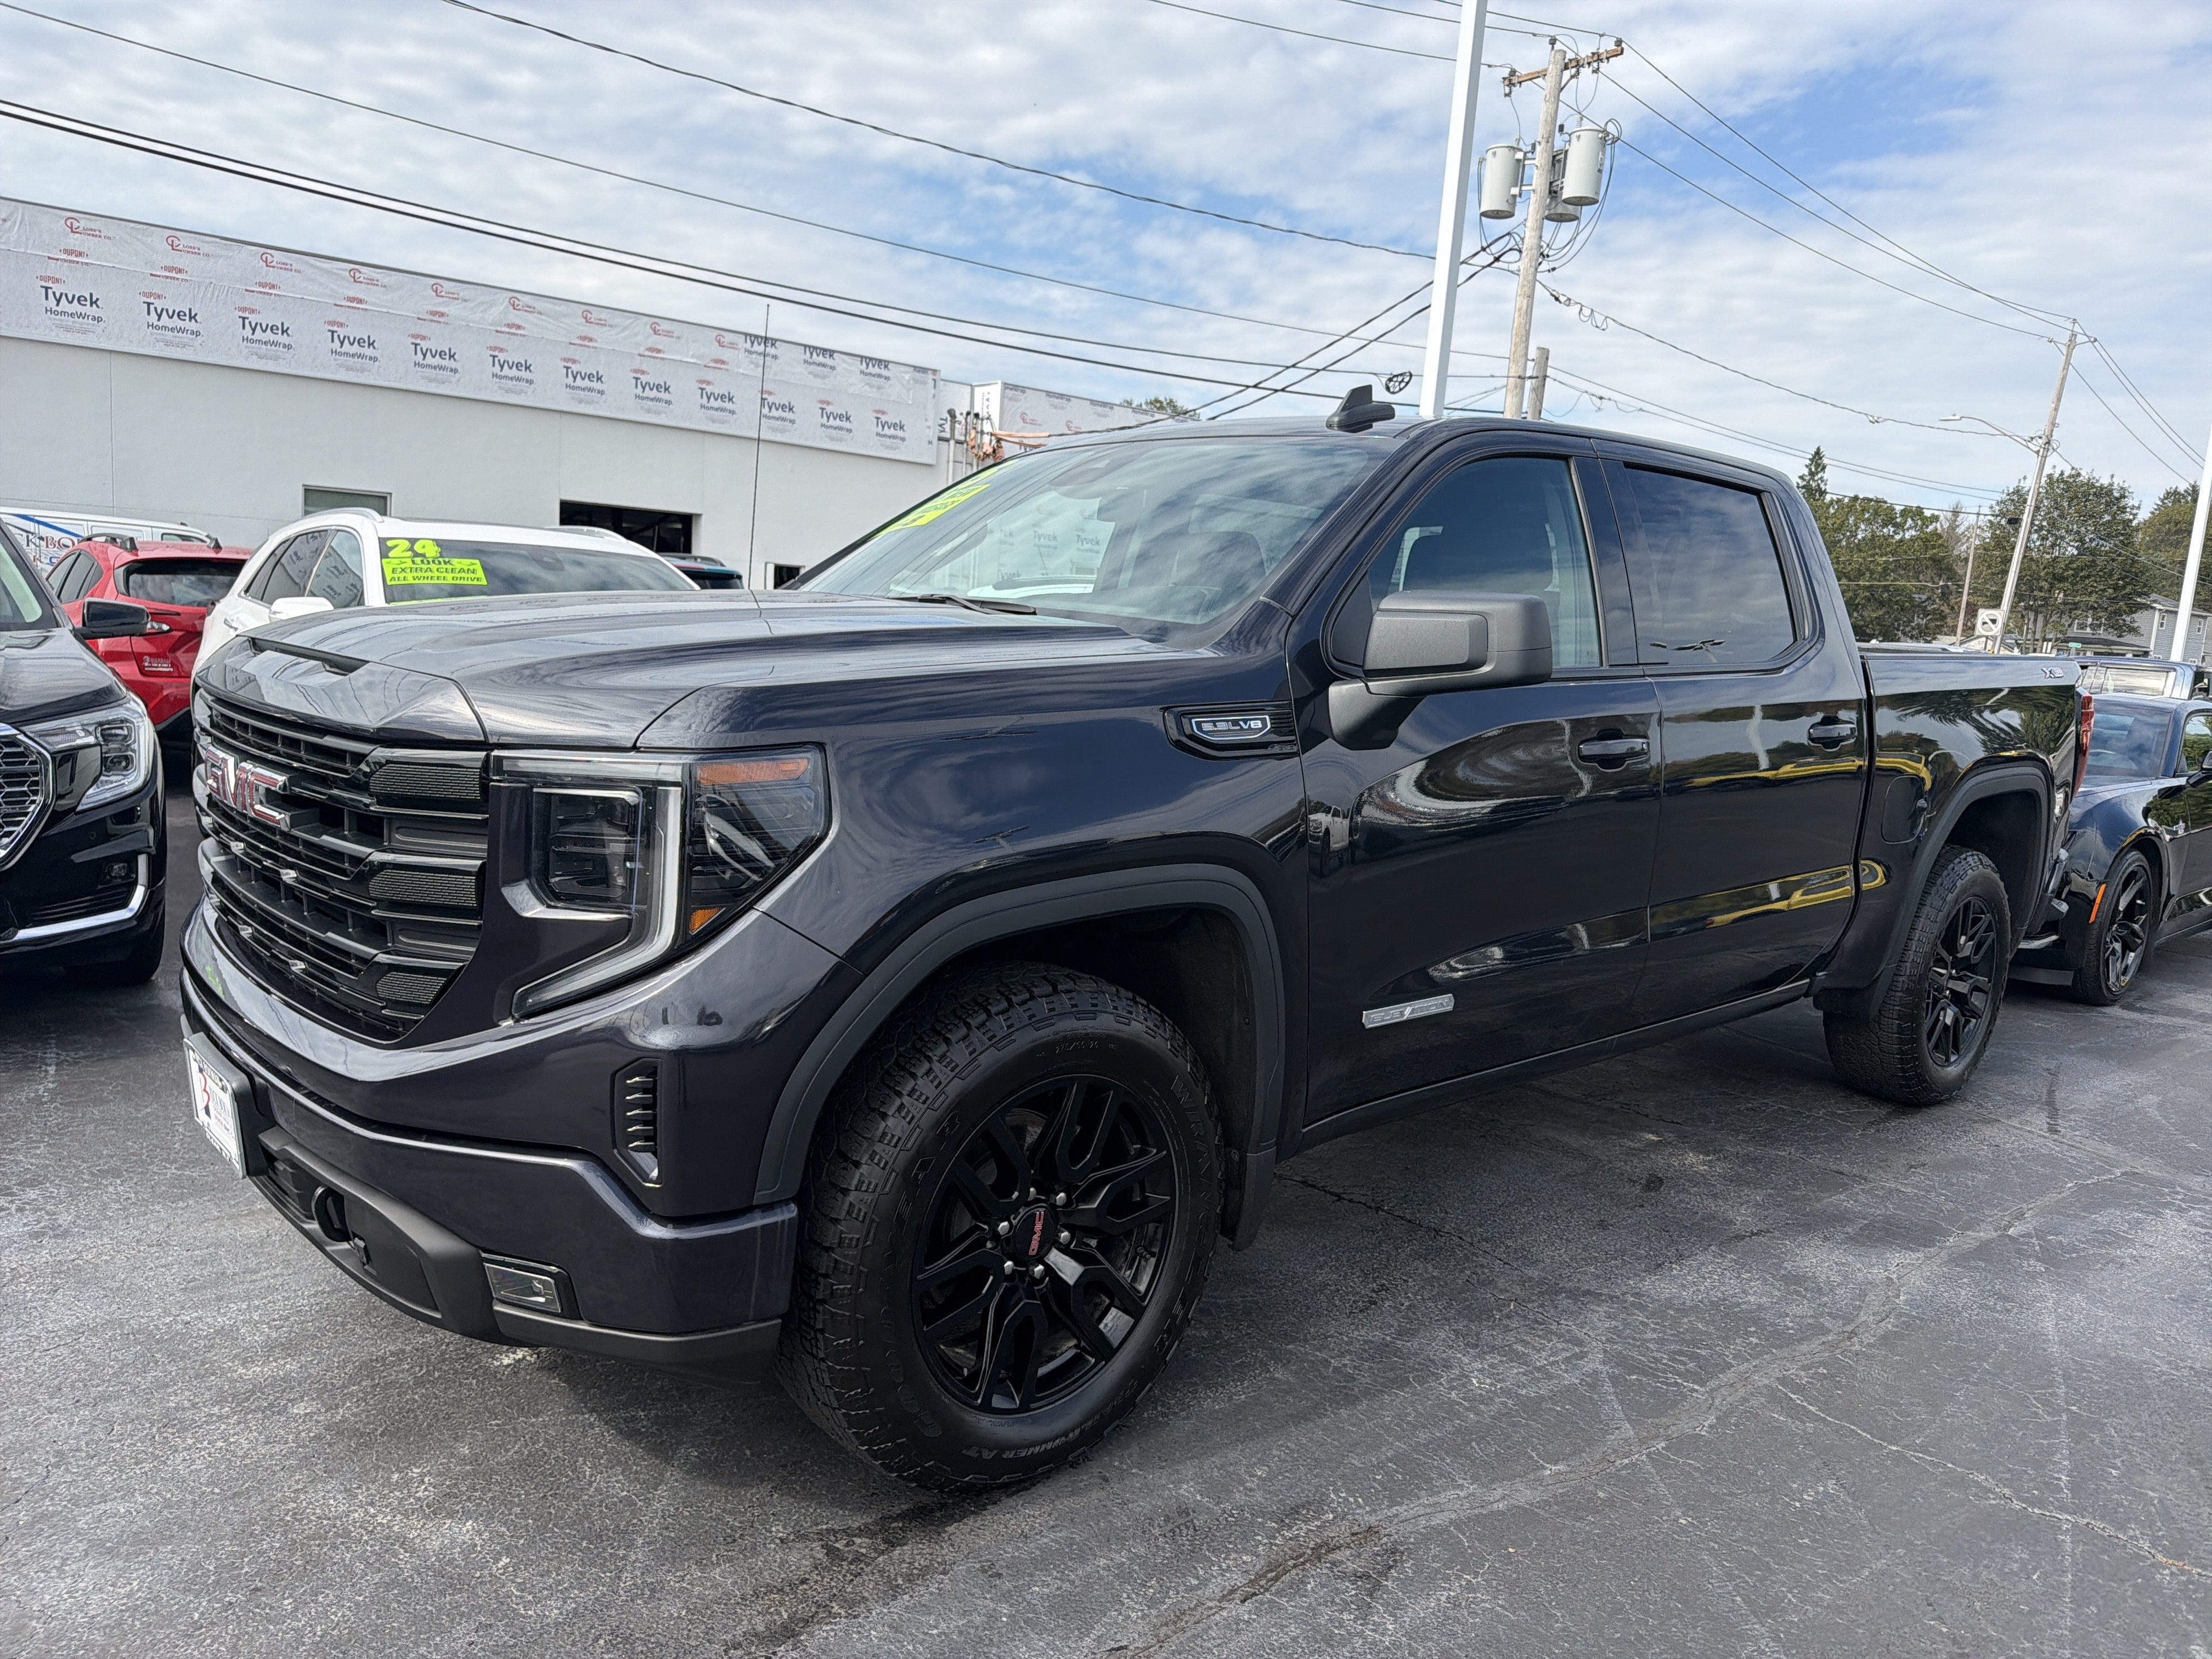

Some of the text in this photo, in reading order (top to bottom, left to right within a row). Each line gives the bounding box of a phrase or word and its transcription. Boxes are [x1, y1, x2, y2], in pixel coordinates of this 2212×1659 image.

[63, 248, 84, 258] DUPONT
[164, 265, 184, 274] DUPONT
[40, 275, 62, 285] DUPONT
[40, 285, 100, 309] Tyvek
[142, 291, 163, 300] DUPONT
[45, 306, 103, 324] HomeWrap
[143, 301, 199, 323] Tyvek
[147, 321, 201, 338] HomeWrap
[238, 315, 290, 337] Tyvek
[242, 335, 293, 351] HomeWrap
[328, 329, 376, 350] Tyvek
[331, 348, 379, 363] HomeWrap
[411, 342, 456, 362] Tyvek
[414, 360, 459, 375] HomeWrap
[490, 354, 532, 373] Tyvek
[804, 359, 836, 371] HomeWrap
[492, 372, 534, 386] HomeWrap
[563, 365, 604, 383] Tyvek
[860, 370, 891, 382] HomeWrap
[566, 383, 605, 396] HomeWrap
[633, 377, 671, 394] Tyvek
[635, 394, 673, 406] HomeWrap
[698, 387, 735, 404] Tyvek
[701, 404, 736, 415] HomeWrap
[761, 398, 795, 414] Tyvek
[763, 414, 796, 425] HomeWrap
[819, 407, 852, 423] Tyvek
[821, 423, 853, 433] HomeWrap
[874, 416, 905, 432] Tyvek
[1033, 531, 1058, 542] Tyvek
[1076, 534, 1101, 546] Tyvek
[386, 539, 441, 558] 24
[205, 746, 292, 831] GMC
[1028, 1211, 1045, 1256] GMC
